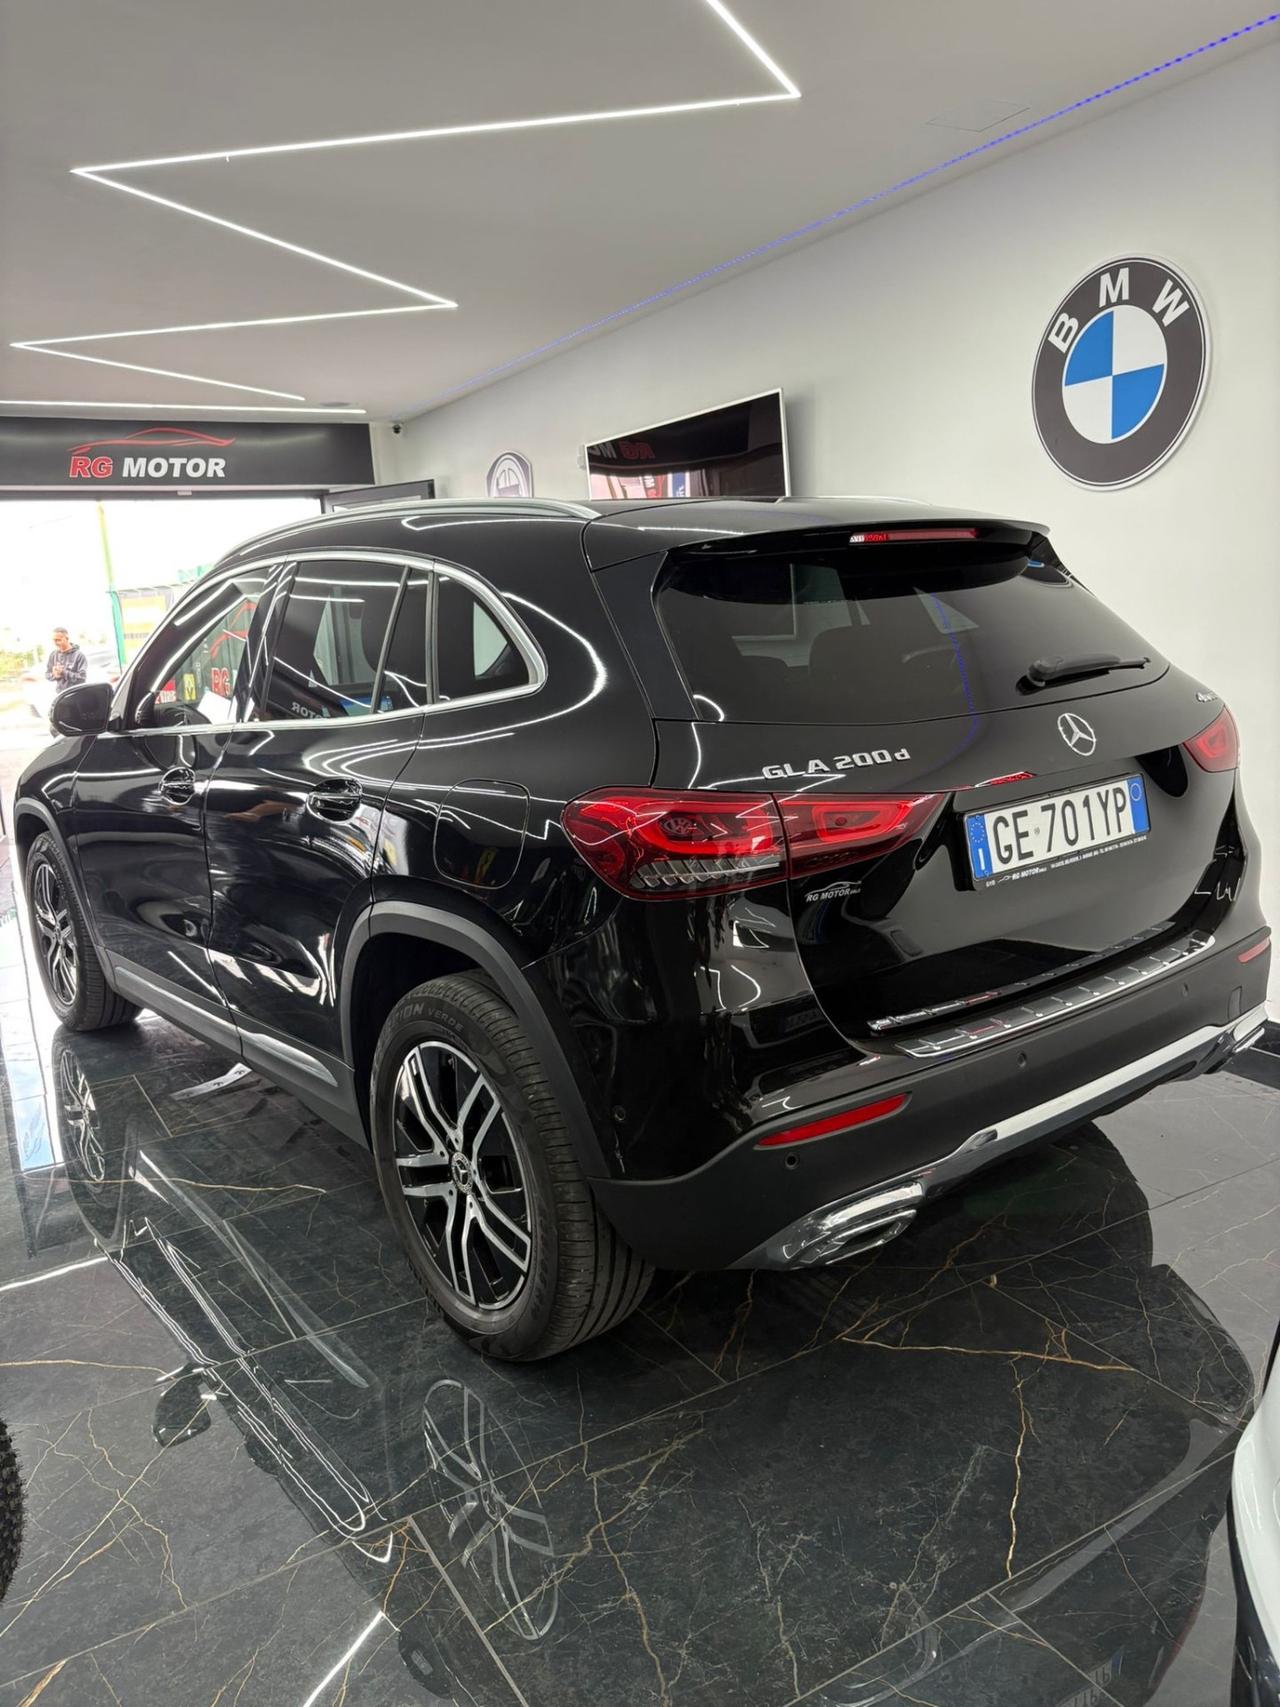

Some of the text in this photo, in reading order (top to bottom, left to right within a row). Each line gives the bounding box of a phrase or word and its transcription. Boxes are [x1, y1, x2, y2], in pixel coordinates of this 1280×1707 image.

[1048, 267, 1190, 354] BMW
[69, 456, 226, 478] RG MOTOR
[762, 759, 831, 780] GLA
[993, 810, 1034, 865] GE
[1040, 787, 1127, 852] 701YP
[806, 893, 819, 902] RG
[820, 888, 850, 900] MOTOR
